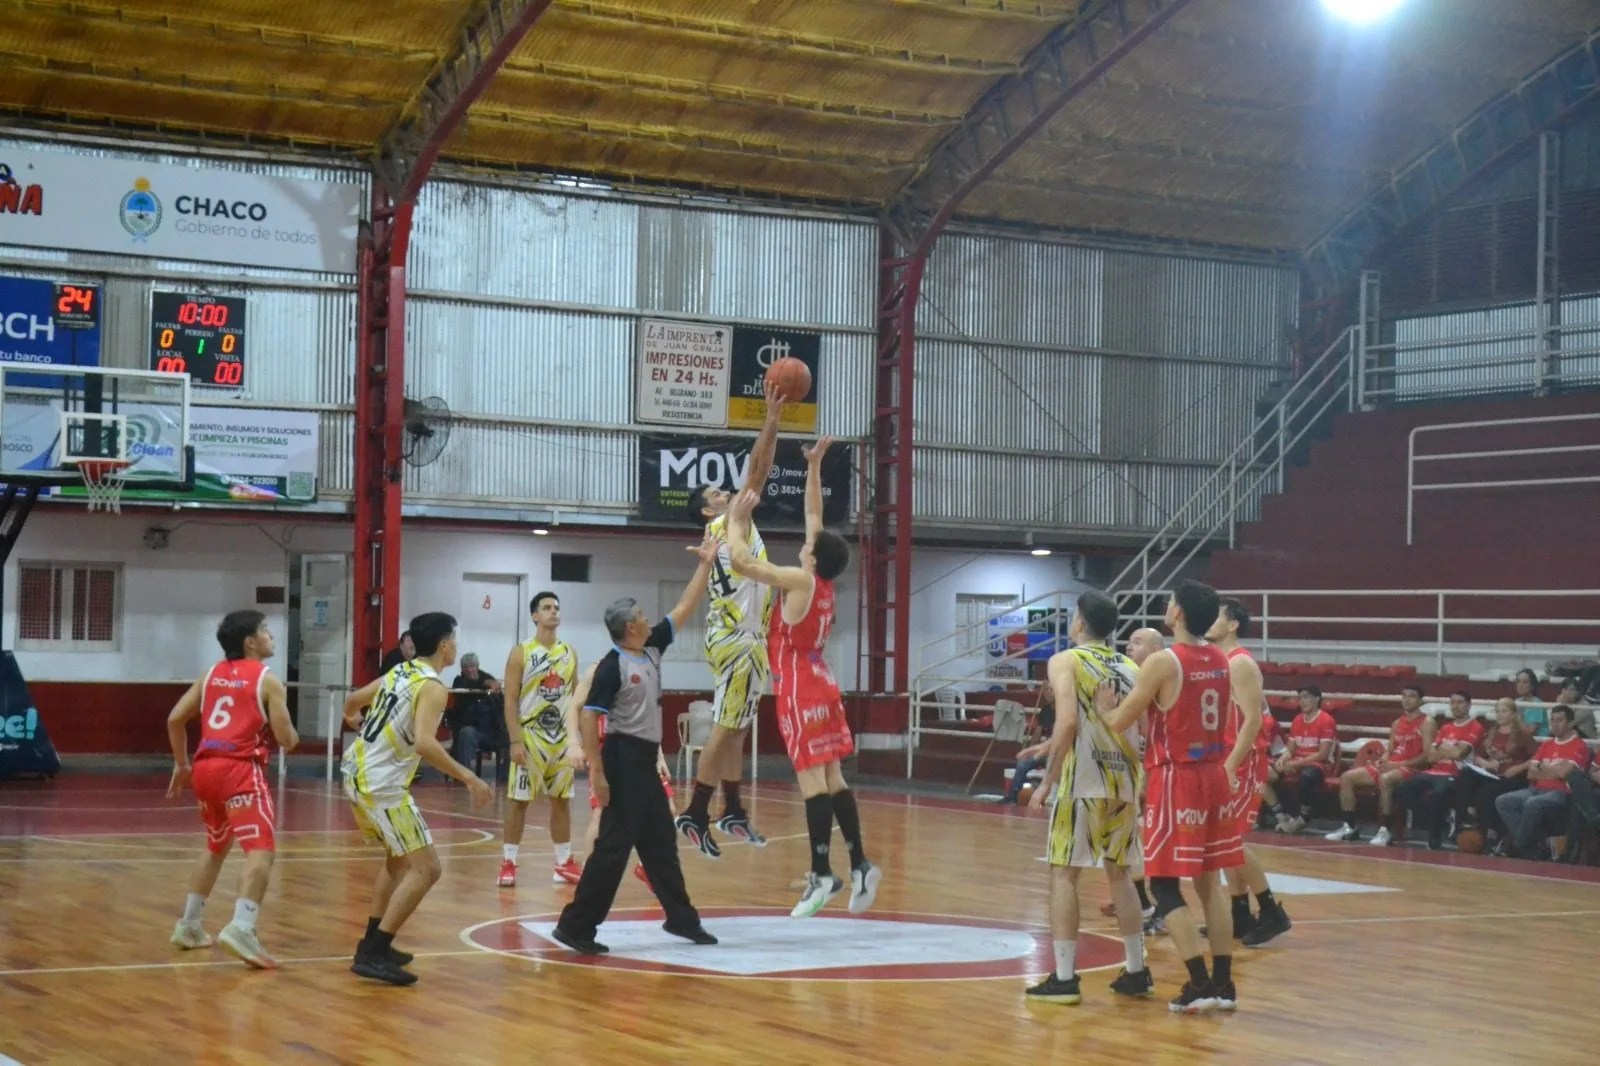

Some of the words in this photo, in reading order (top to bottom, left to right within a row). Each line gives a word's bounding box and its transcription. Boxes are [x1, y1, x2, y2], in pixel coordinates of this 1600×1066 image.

[175, 195, 267, 222] CHACO
[175, 218, 247, 238] Gobierno
[250, 224, 271, 240] de
[274, 227, 317, 245] todos
[58, 286, 93, 313] 24
[178, 303, 228, 327] 10:00
[0, 312, 55, 342] CH
[155, 322, 181, 330] FALTAS
[647, 325, 665, 340] LA
[667, 330, 723, 345] IMPRENTA
[160, 329, 174, 348] 0
[197, 338, 205, 354] 1
[221, 334, 235, 353] 0
[14, 351, 52, 364] banco
[156, 350, 183, 358] LOCAL
[214, 353, 240, 362] VISITA
[646, 351, 725, 370] IMPRESIONES
[214, 361, 242, 384] 00
[651, 368, 669, 382] EN
[674, 369, 694, 384] 24
[699, 372, 718, 387] Hs.
[226, 424, 260, 433] INSUMOS
[267, 427, 312, 435] SOLUCIONES
[199, 434, 238, 443] LIMPIEZA
[240, 436, 246, 444] Y
[247, 436, 288, 446] PISCINAS
[132, 443, 174, 457] Clean
[660, 448, 750, 490] MOV
[208, 695, 235, 730] 6
[1200, 688, 1220, 731] 8
[1176, 807, 1208, 825] MOV
